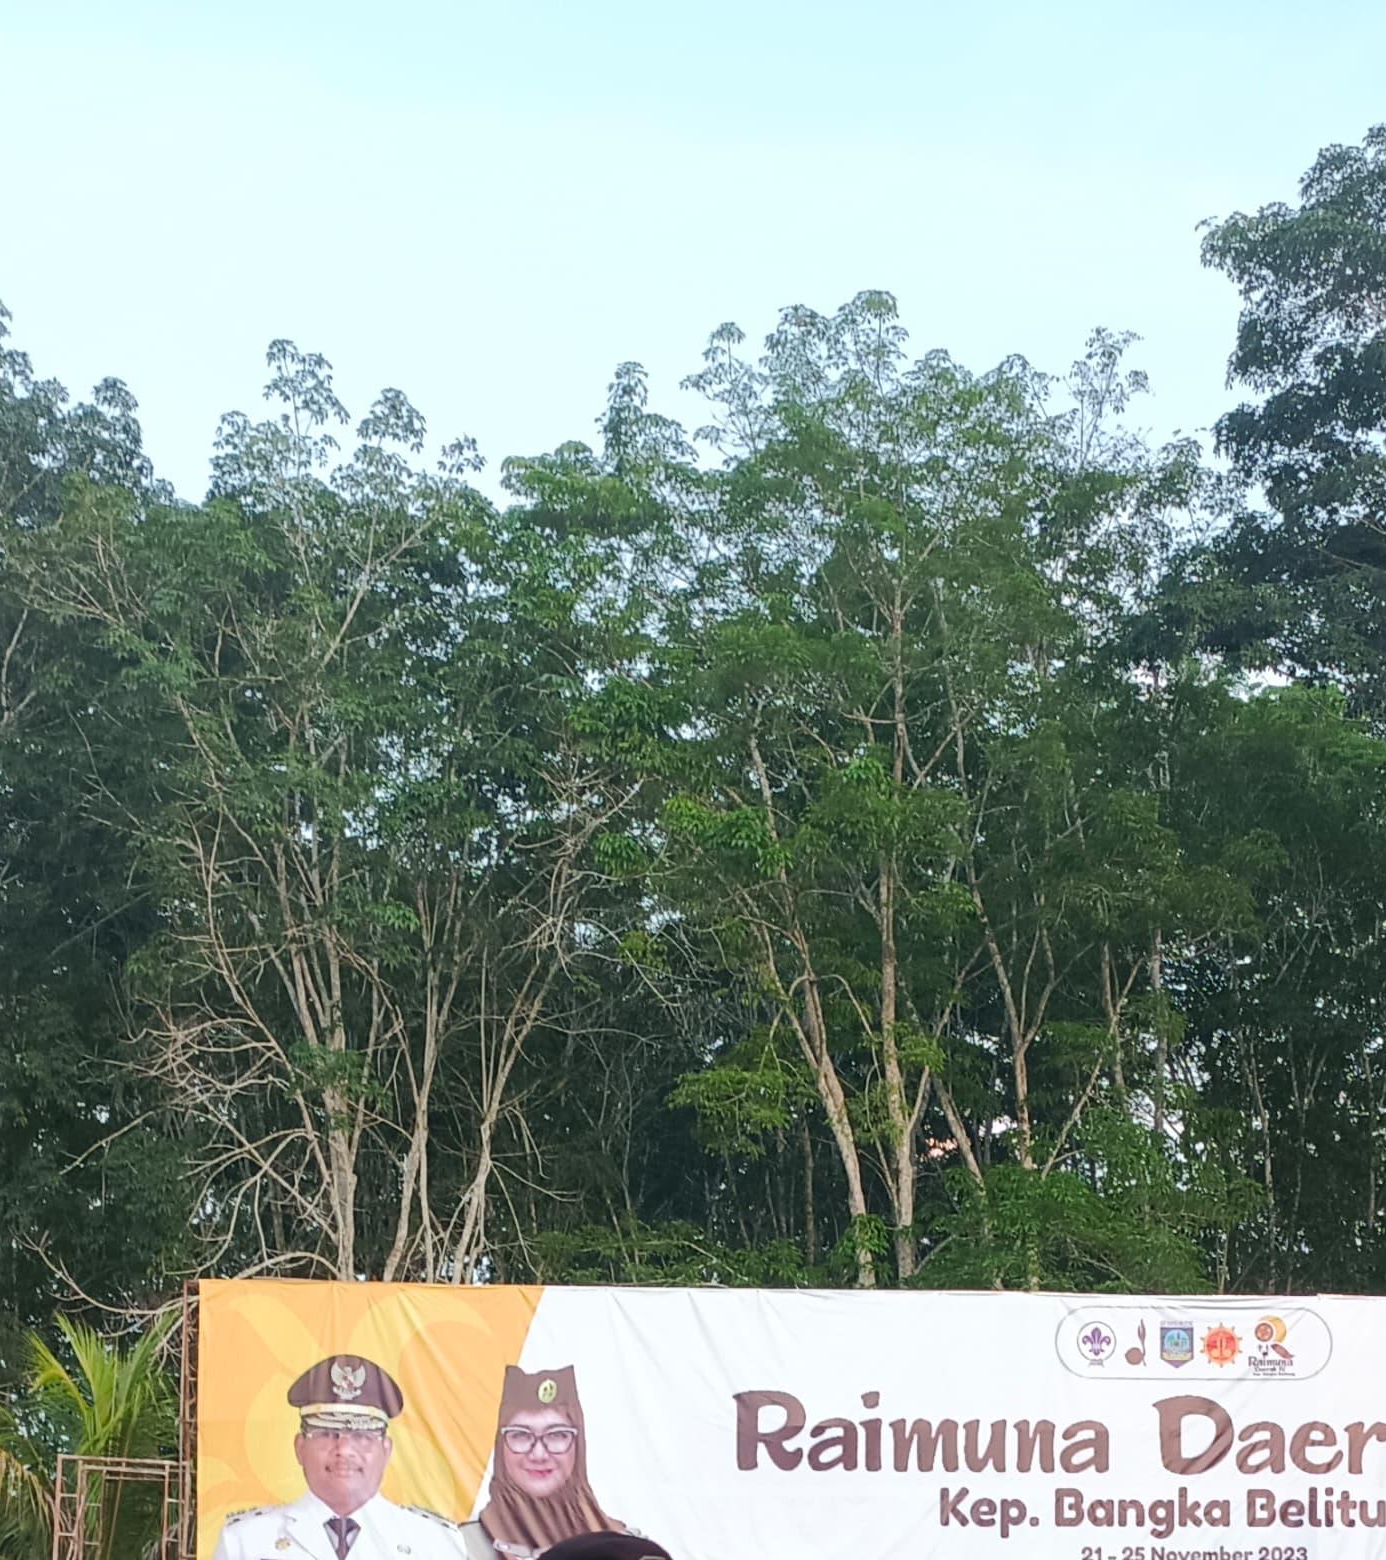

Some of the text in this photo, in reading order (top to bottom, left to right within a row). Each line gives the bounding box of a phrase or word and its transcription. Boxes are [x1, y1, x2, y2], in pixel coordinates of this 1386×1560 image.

[732, 1390, 1110, 1473] Raimuna
[939, 1487, 1039, 1538] Kep.
[1054, 1487, 1231, 1539] Bangka
